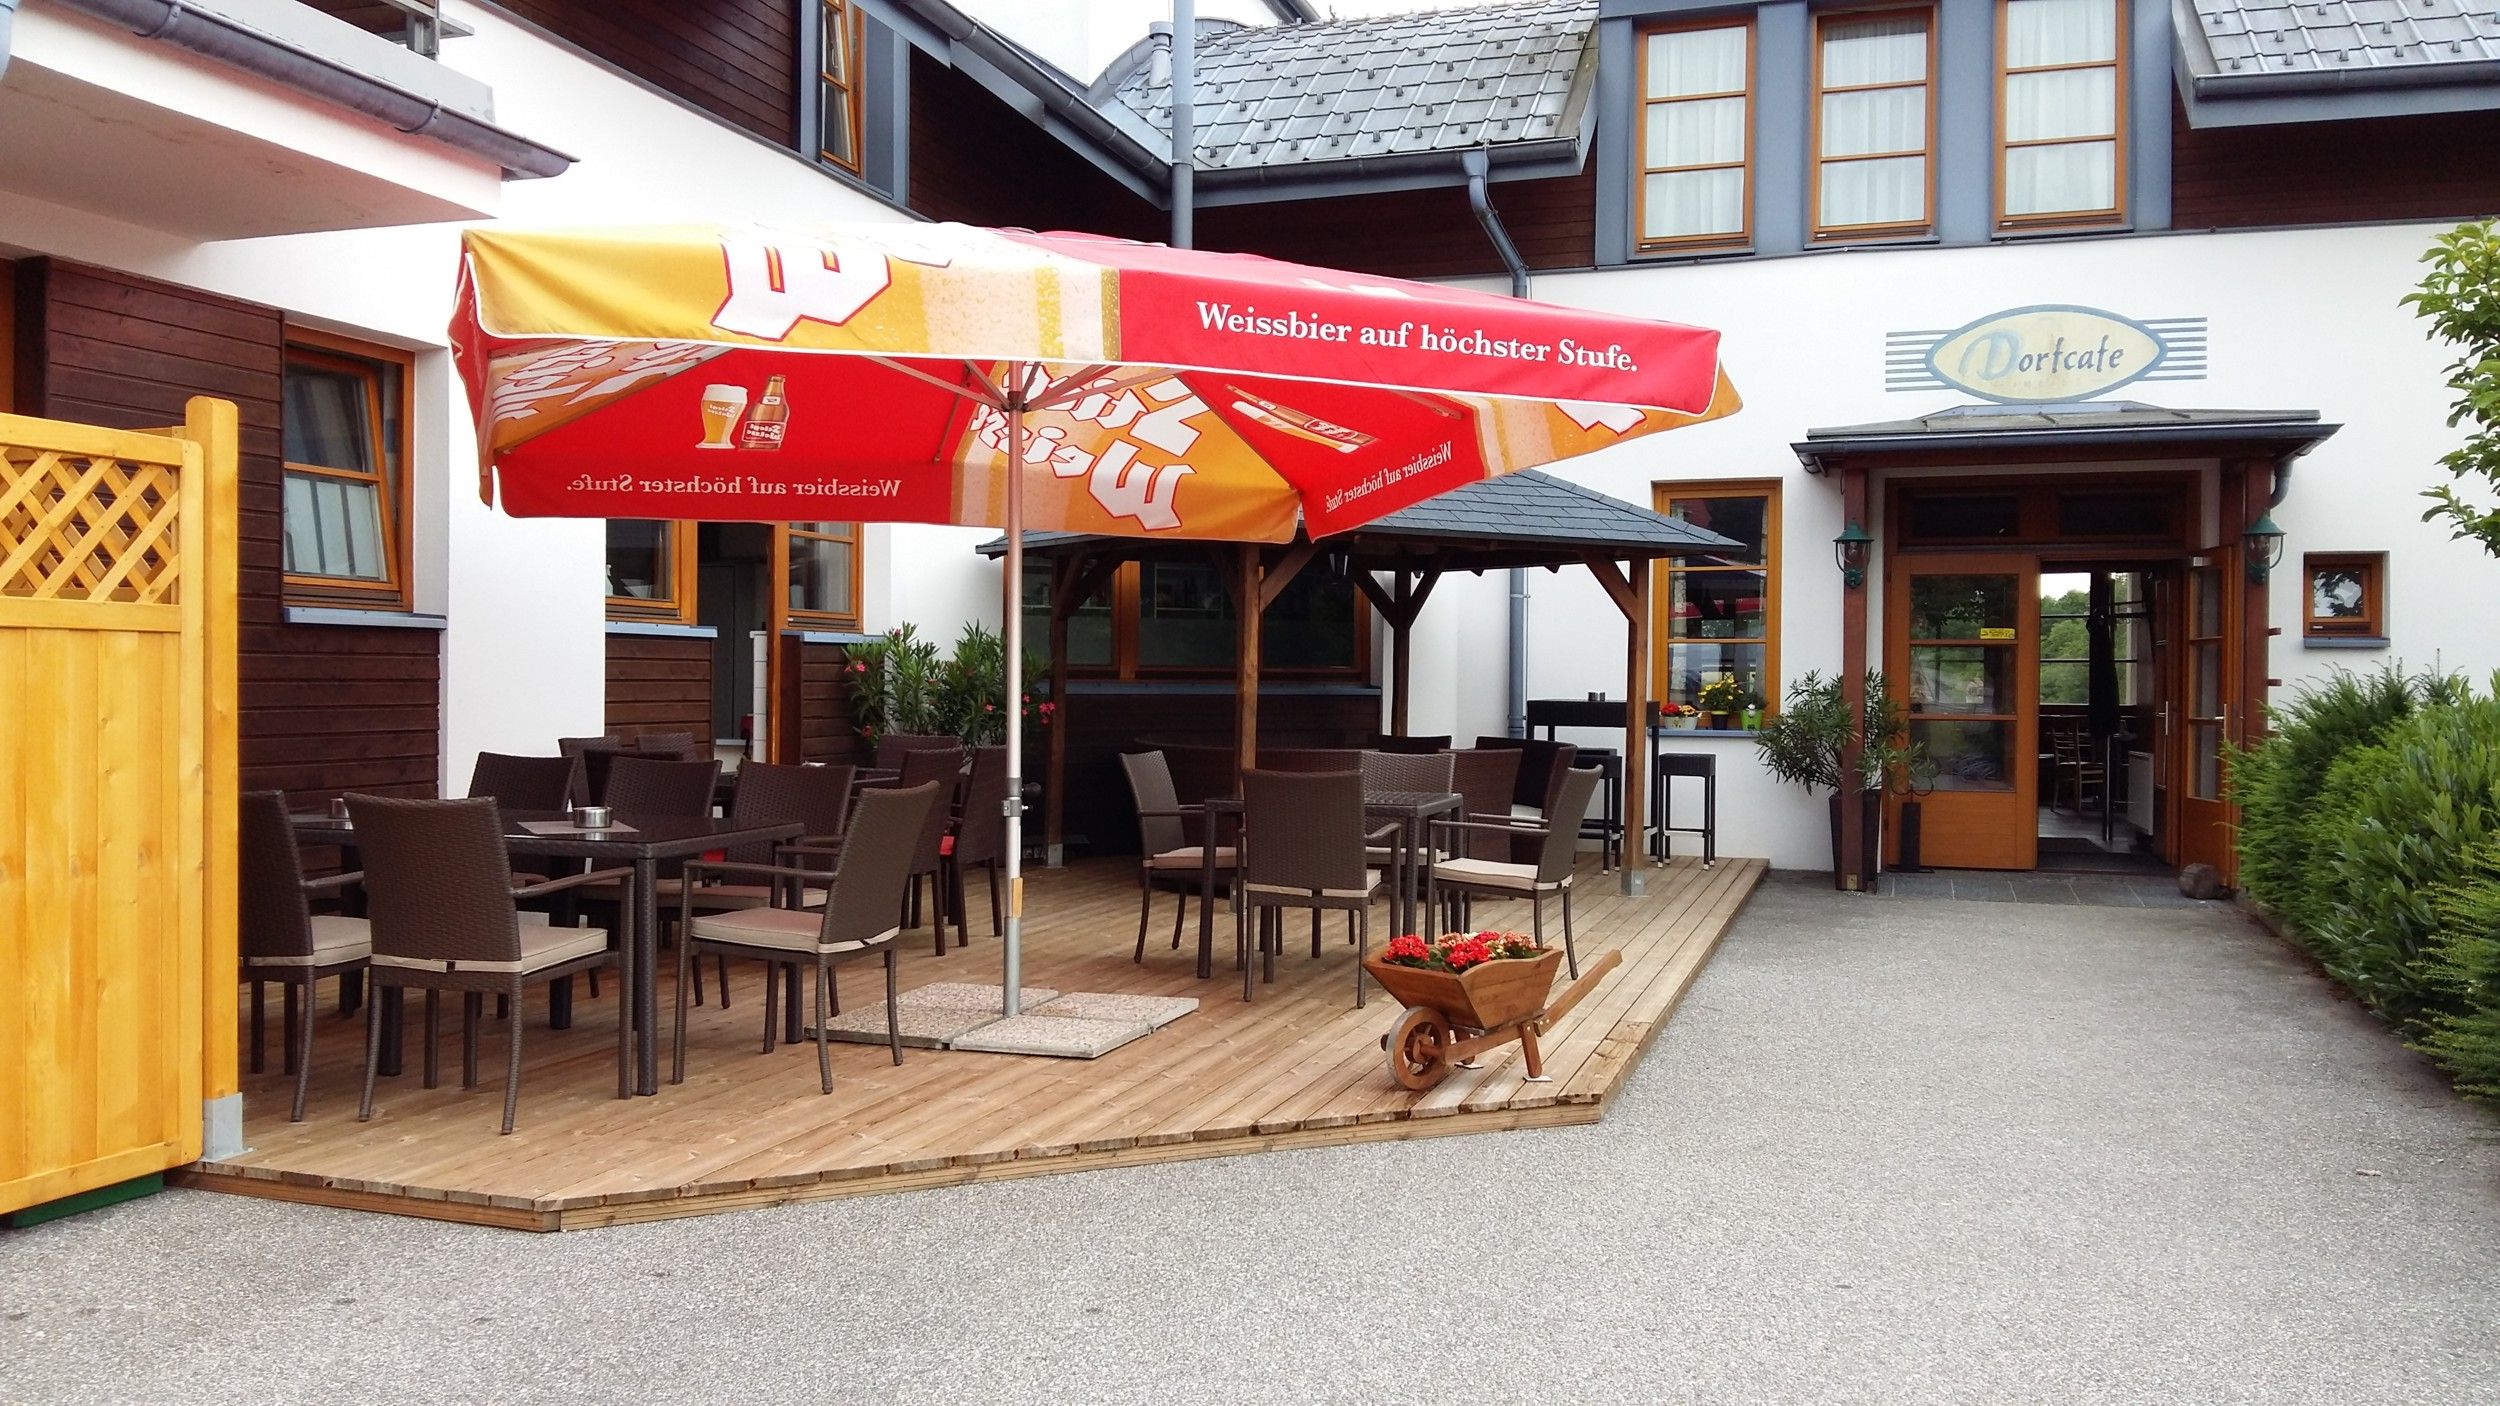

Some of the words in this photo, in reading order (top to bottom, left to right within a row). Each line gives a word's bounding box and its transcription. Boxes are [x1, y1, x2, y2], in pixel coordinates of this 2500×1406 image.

[1196, 300, 1352, 343] Weissbier
[1359, 322, 1414, 349] auf
[1419, 323, 1551, 362] höchster
[1557, 338, 1639, 373] Stufe.
